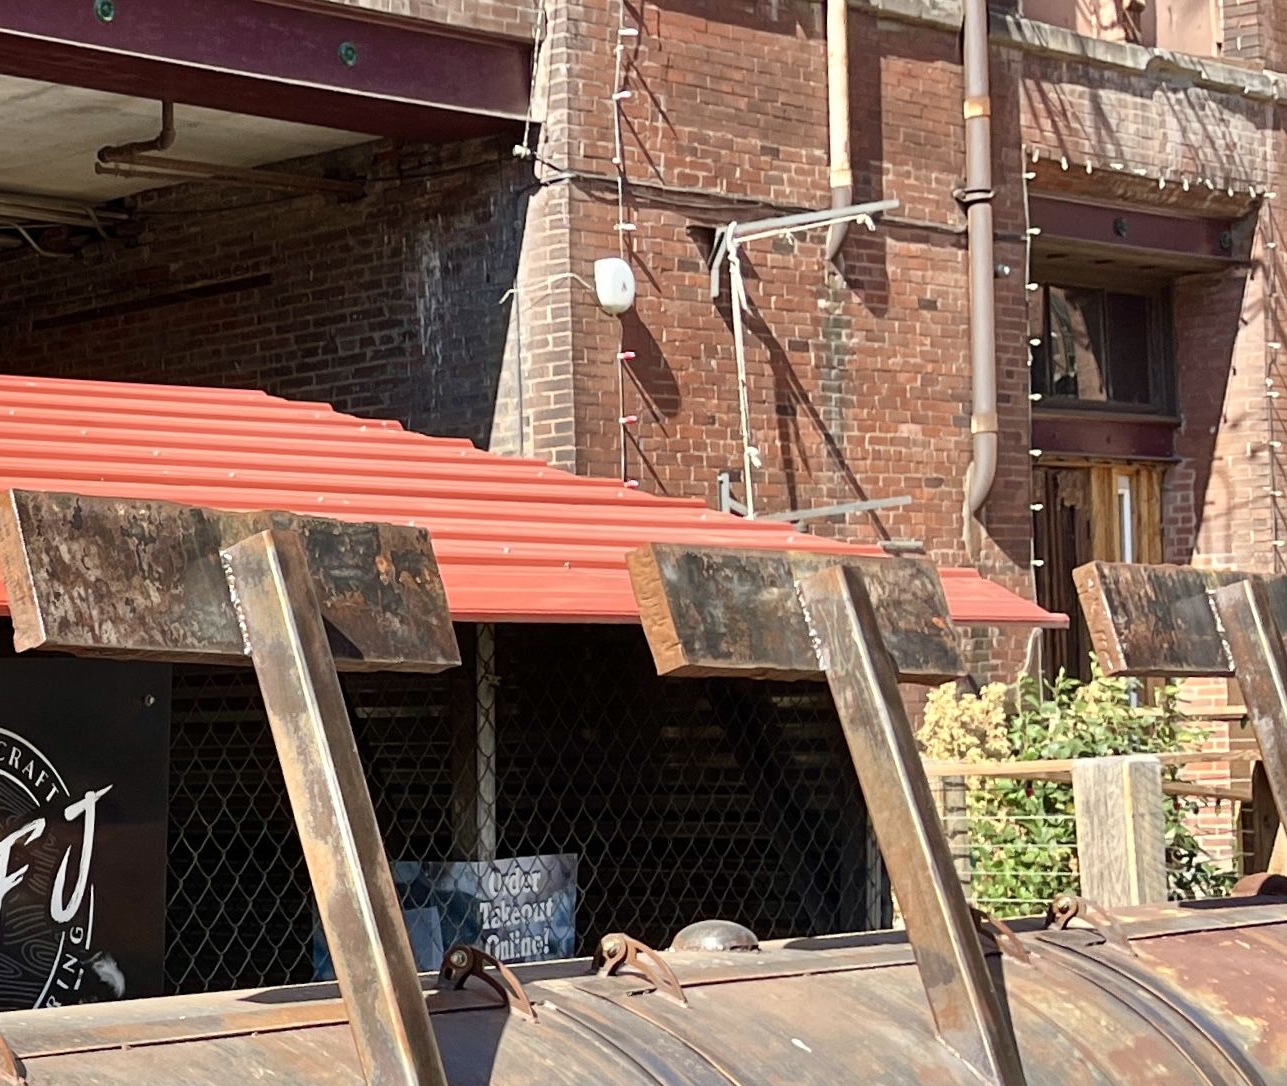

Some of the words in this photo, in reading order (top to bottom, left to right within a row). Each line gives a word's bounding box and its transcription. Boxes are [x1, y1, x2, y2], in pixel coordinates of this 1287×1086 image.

[49, 783, 114, 924] J
[487, 865, 542, 895] Order
[479, 897, 555, 931] Takeout
[483, 926, 551, 962] Online!
